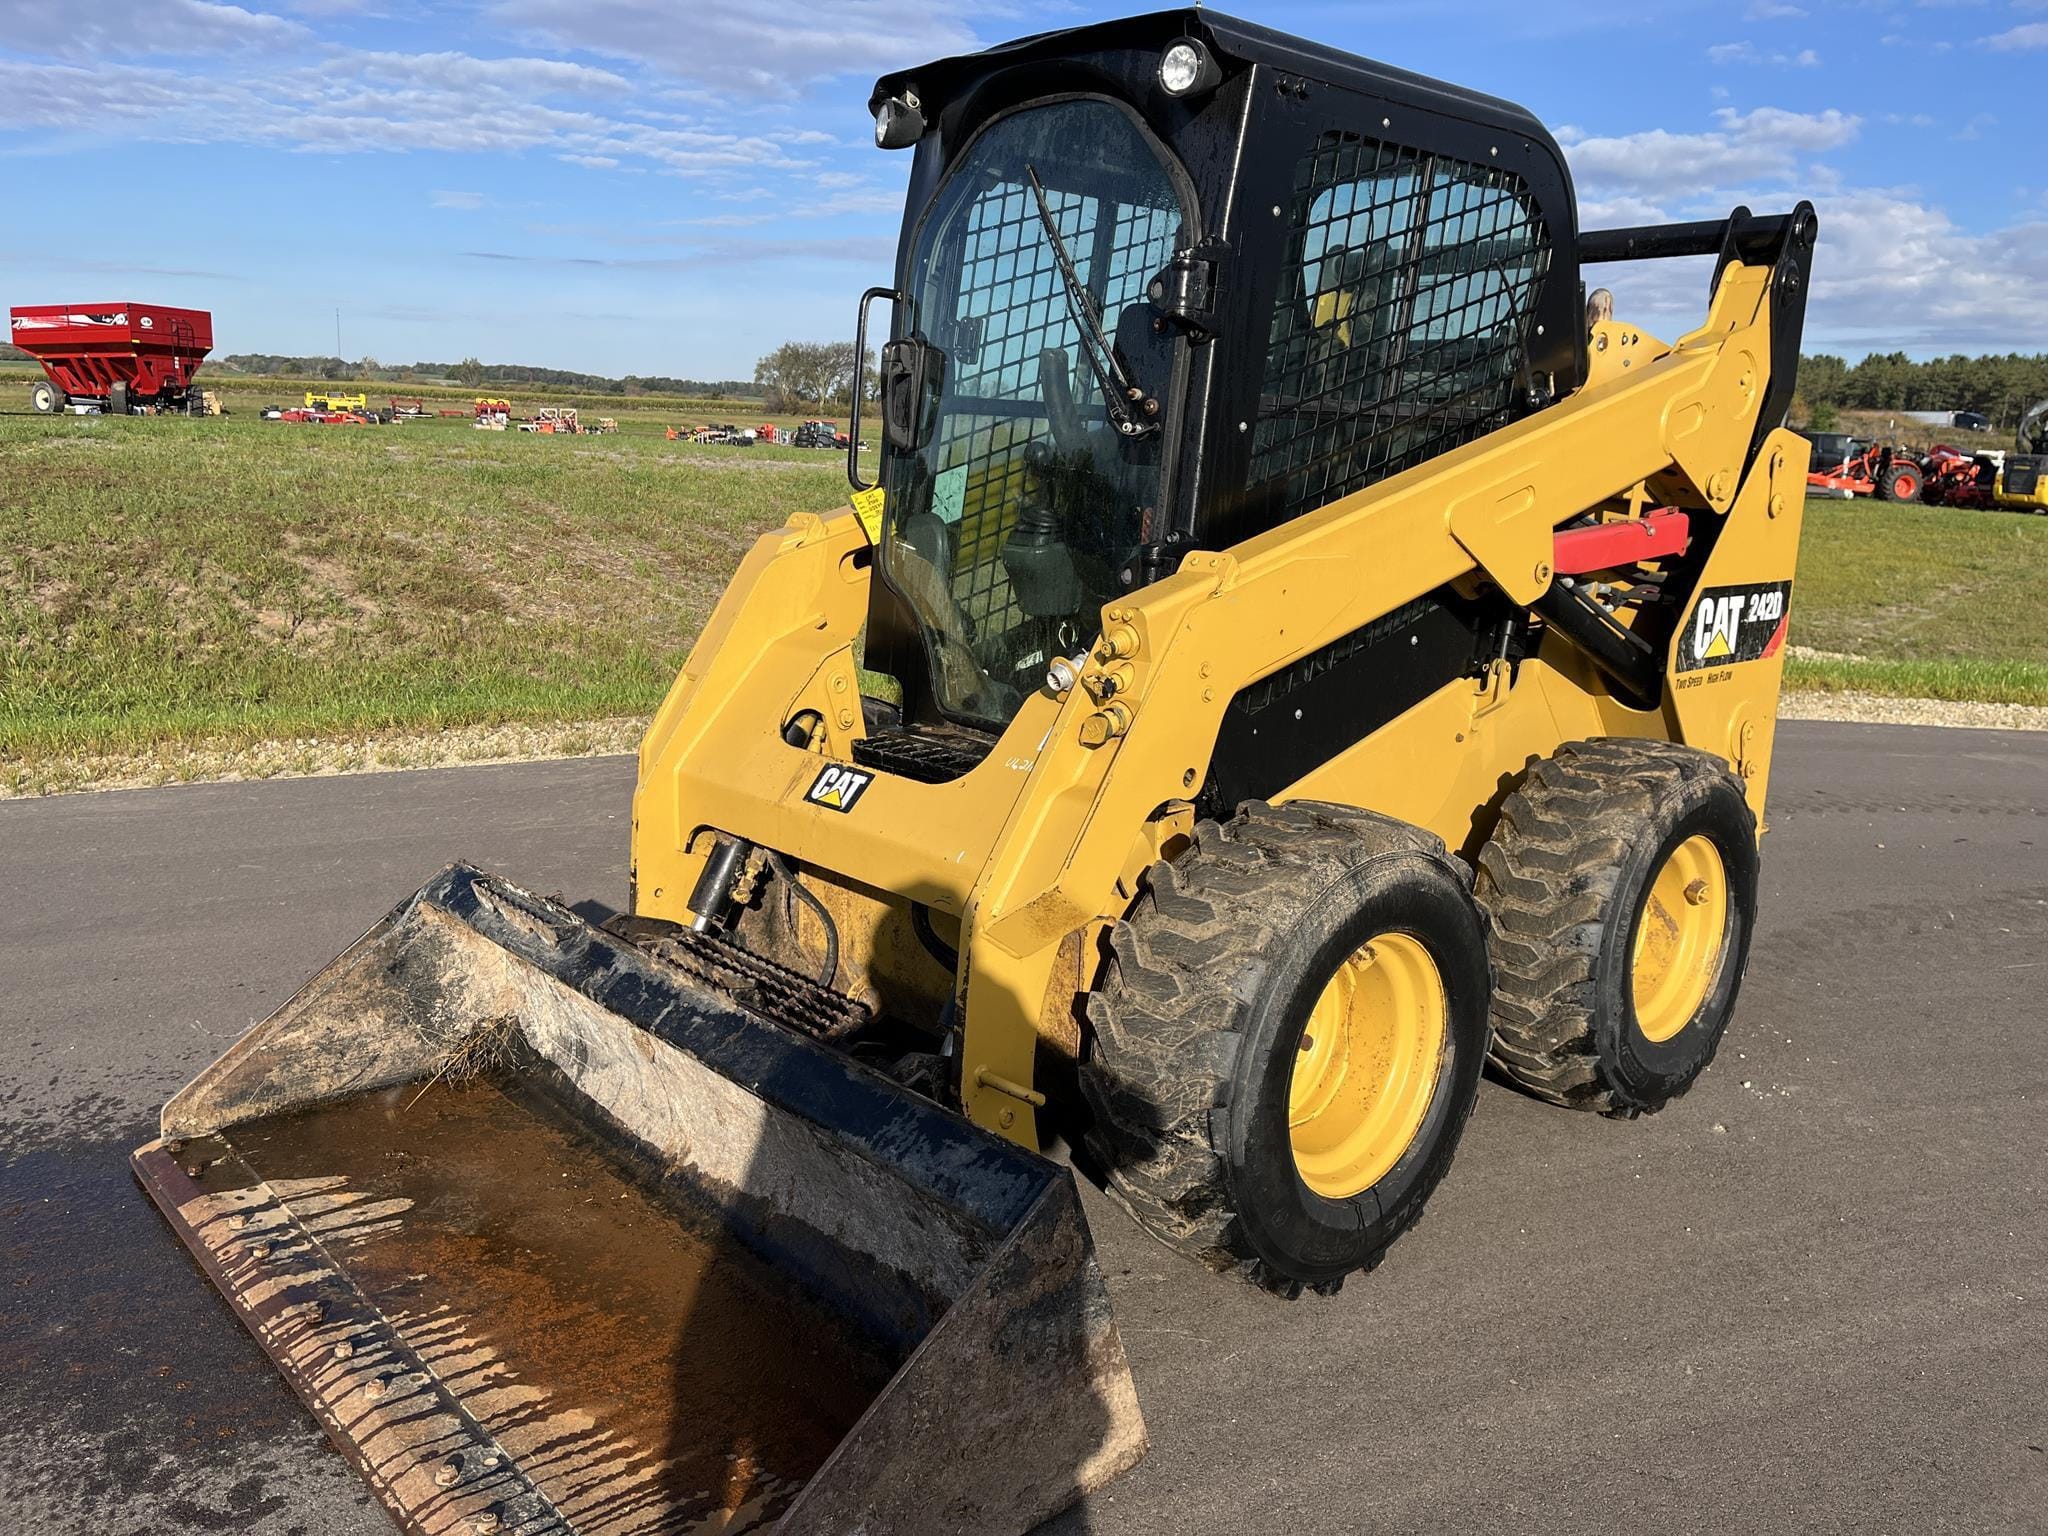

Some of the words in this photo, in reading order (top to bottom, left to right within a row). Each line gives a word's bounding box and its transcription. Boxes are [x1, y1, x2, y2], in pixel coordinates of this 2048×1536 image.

[1694, 595, 1745, 660] CAT
[1748, 591, 1783, 623] 242D
[811, 767, 868, 810] CAT
